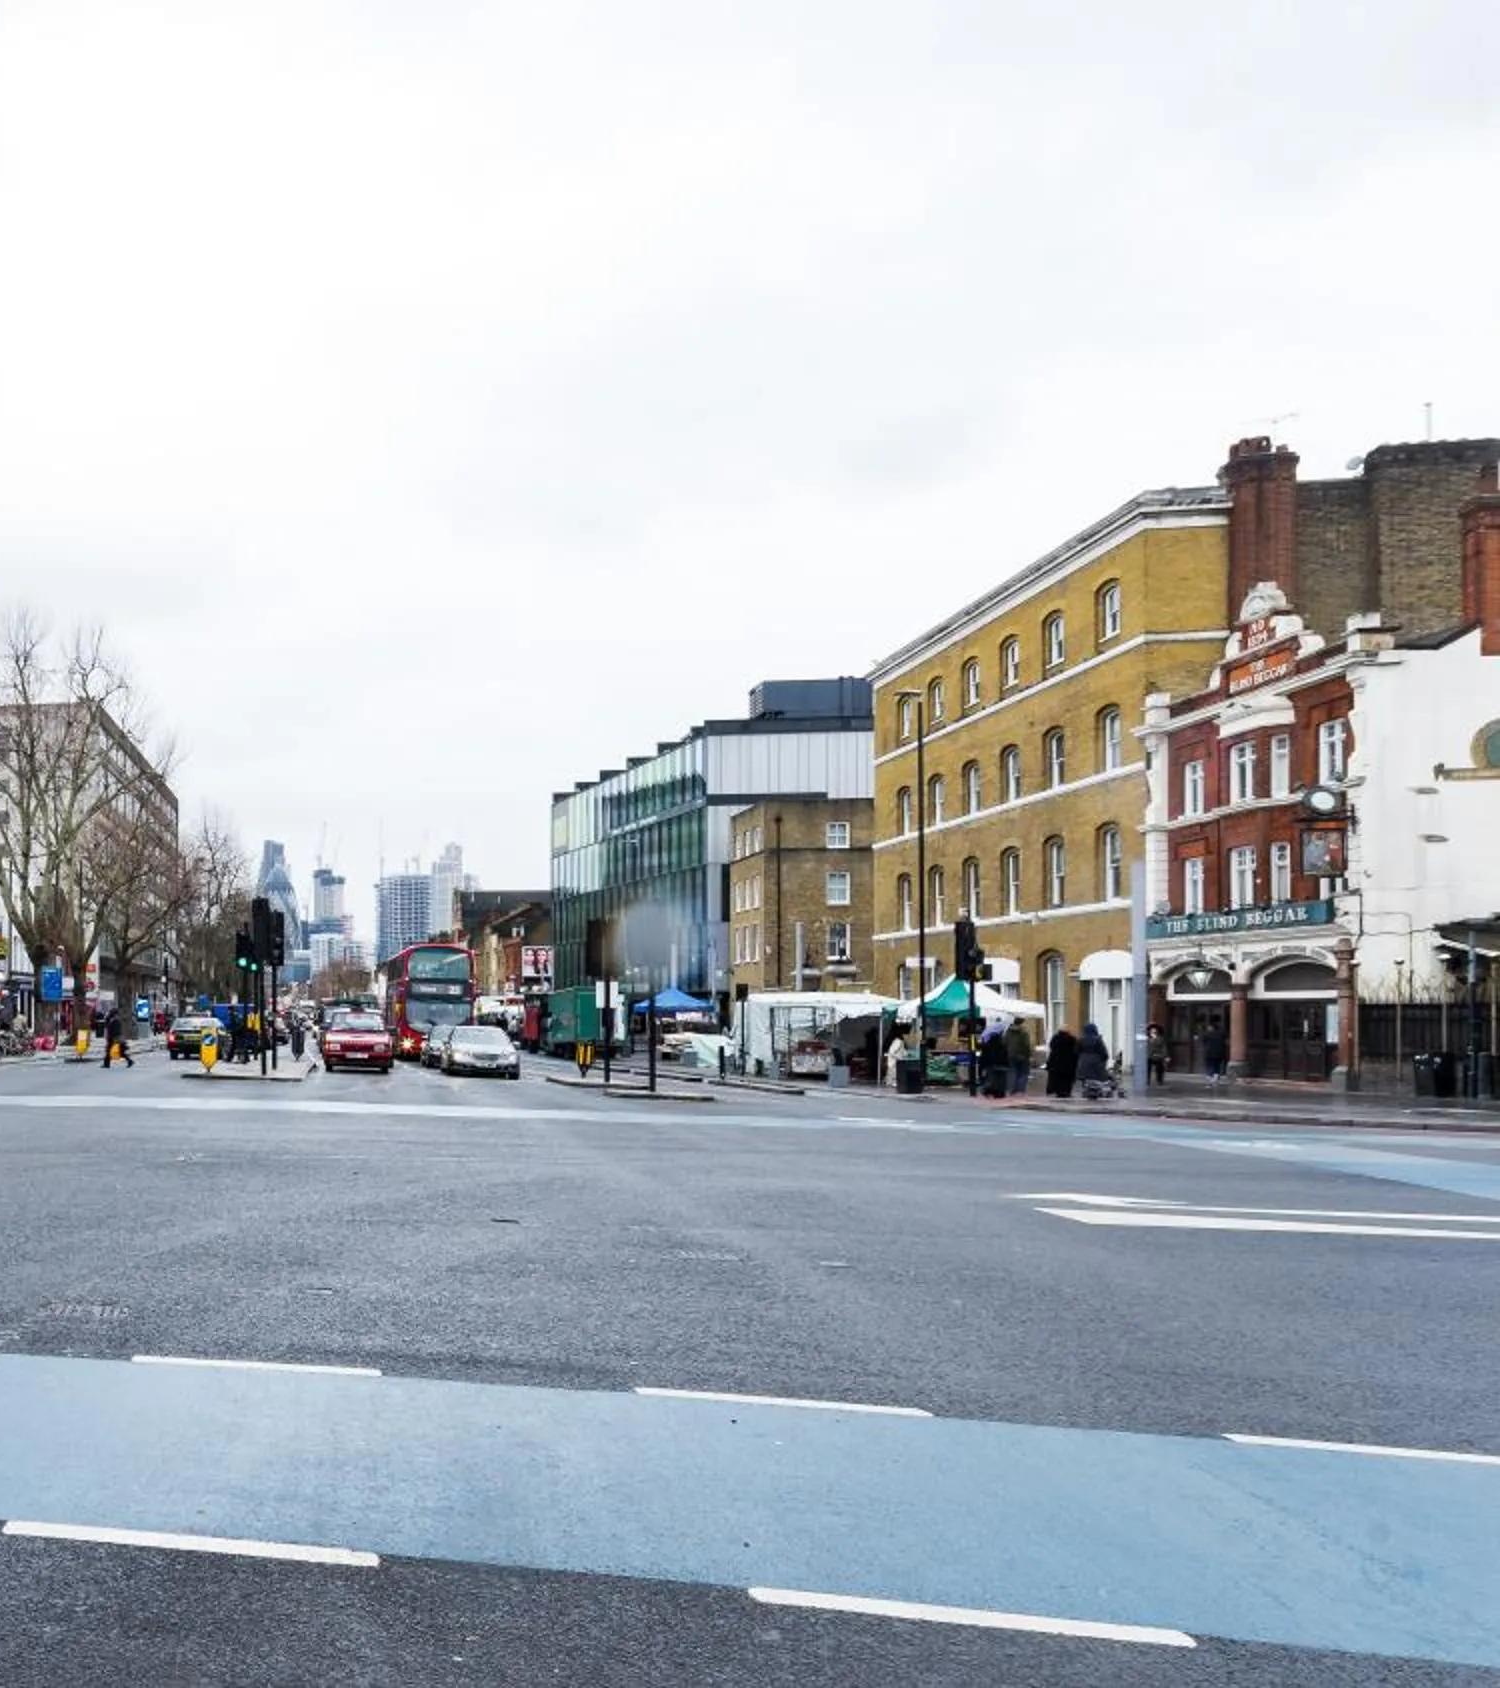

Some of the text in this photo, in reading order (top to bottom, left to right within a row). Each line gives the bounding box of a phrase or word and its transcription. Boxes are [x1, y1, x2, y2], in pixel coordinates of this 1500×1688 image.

[1167, 907, 1308, 933] THE BLIND BEGGAR
